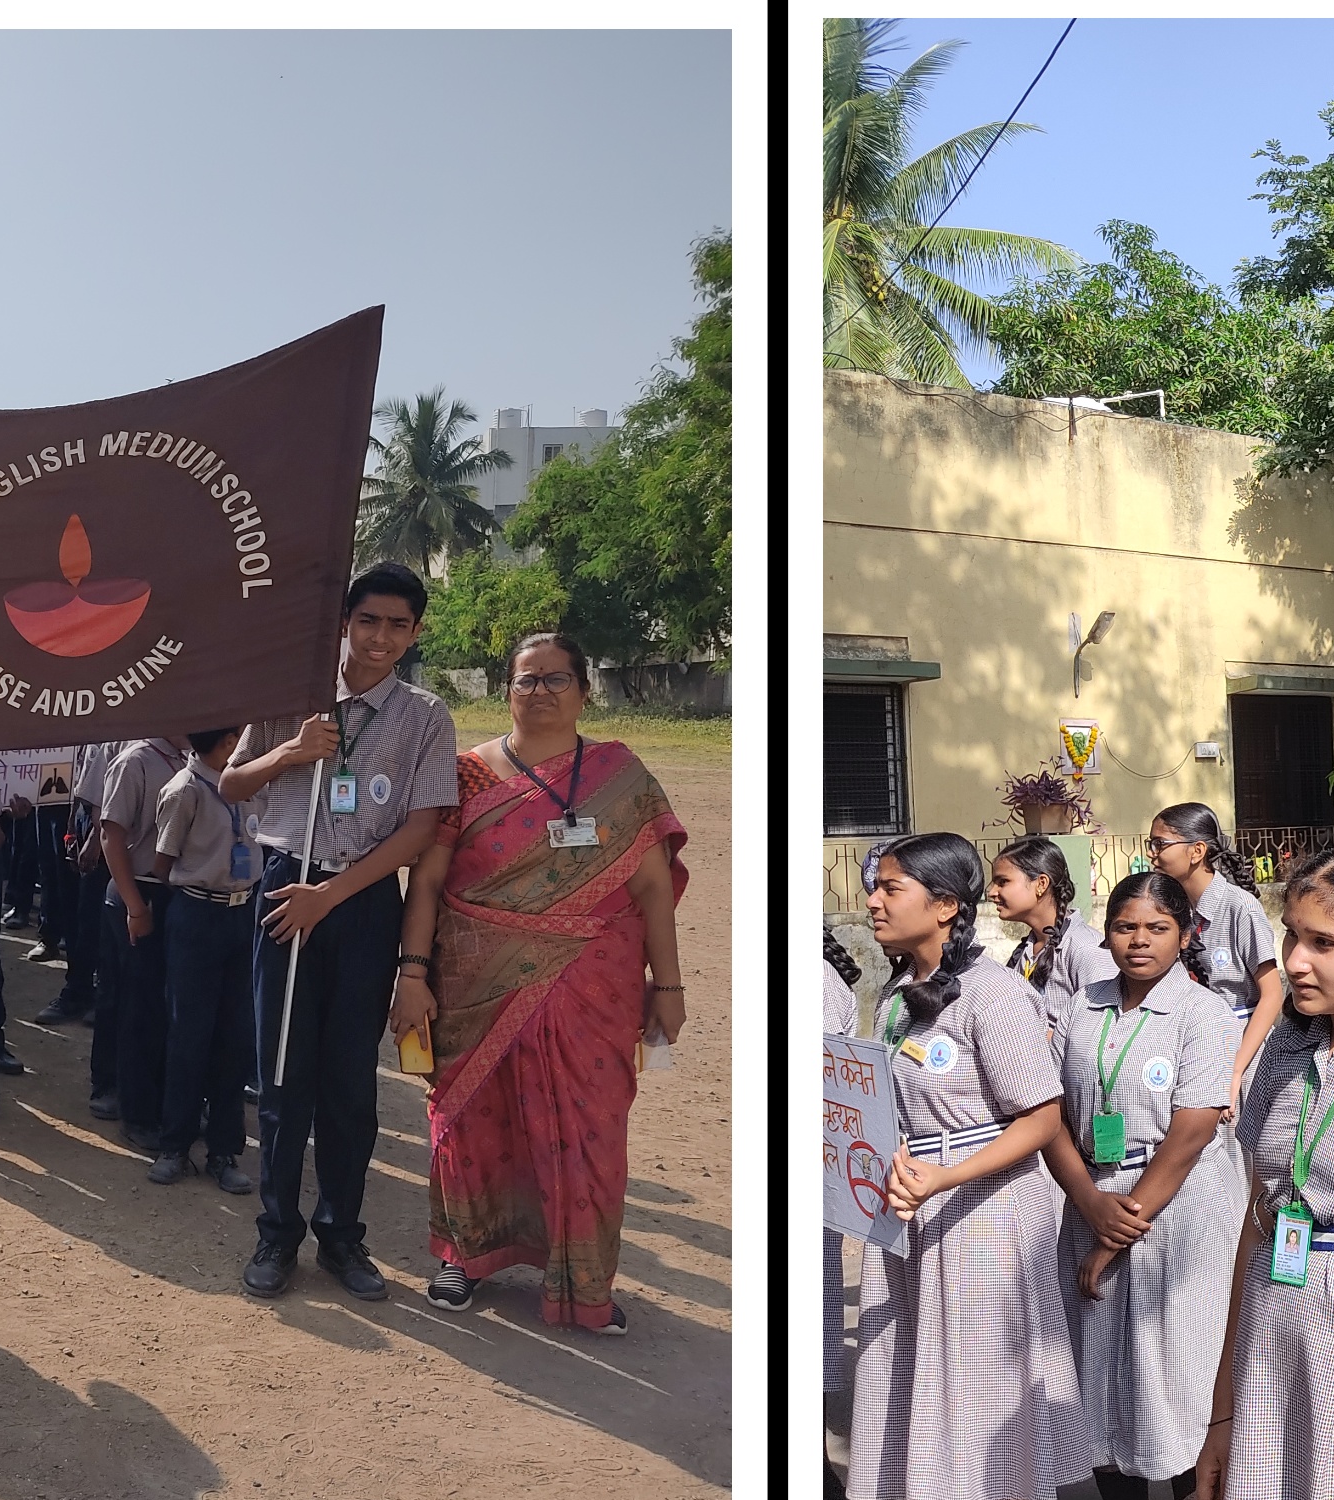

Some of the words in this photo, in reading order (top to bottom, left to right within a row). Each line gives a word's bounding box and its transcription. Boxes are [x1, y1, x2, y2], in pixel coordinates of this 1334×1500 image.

[99, 430, 225, 485] MEDIUM
[210, 474, 273, 599] SCHOOL
[31, 688, 95, 717] AND
[101, 634, 183, 708] SHINE
